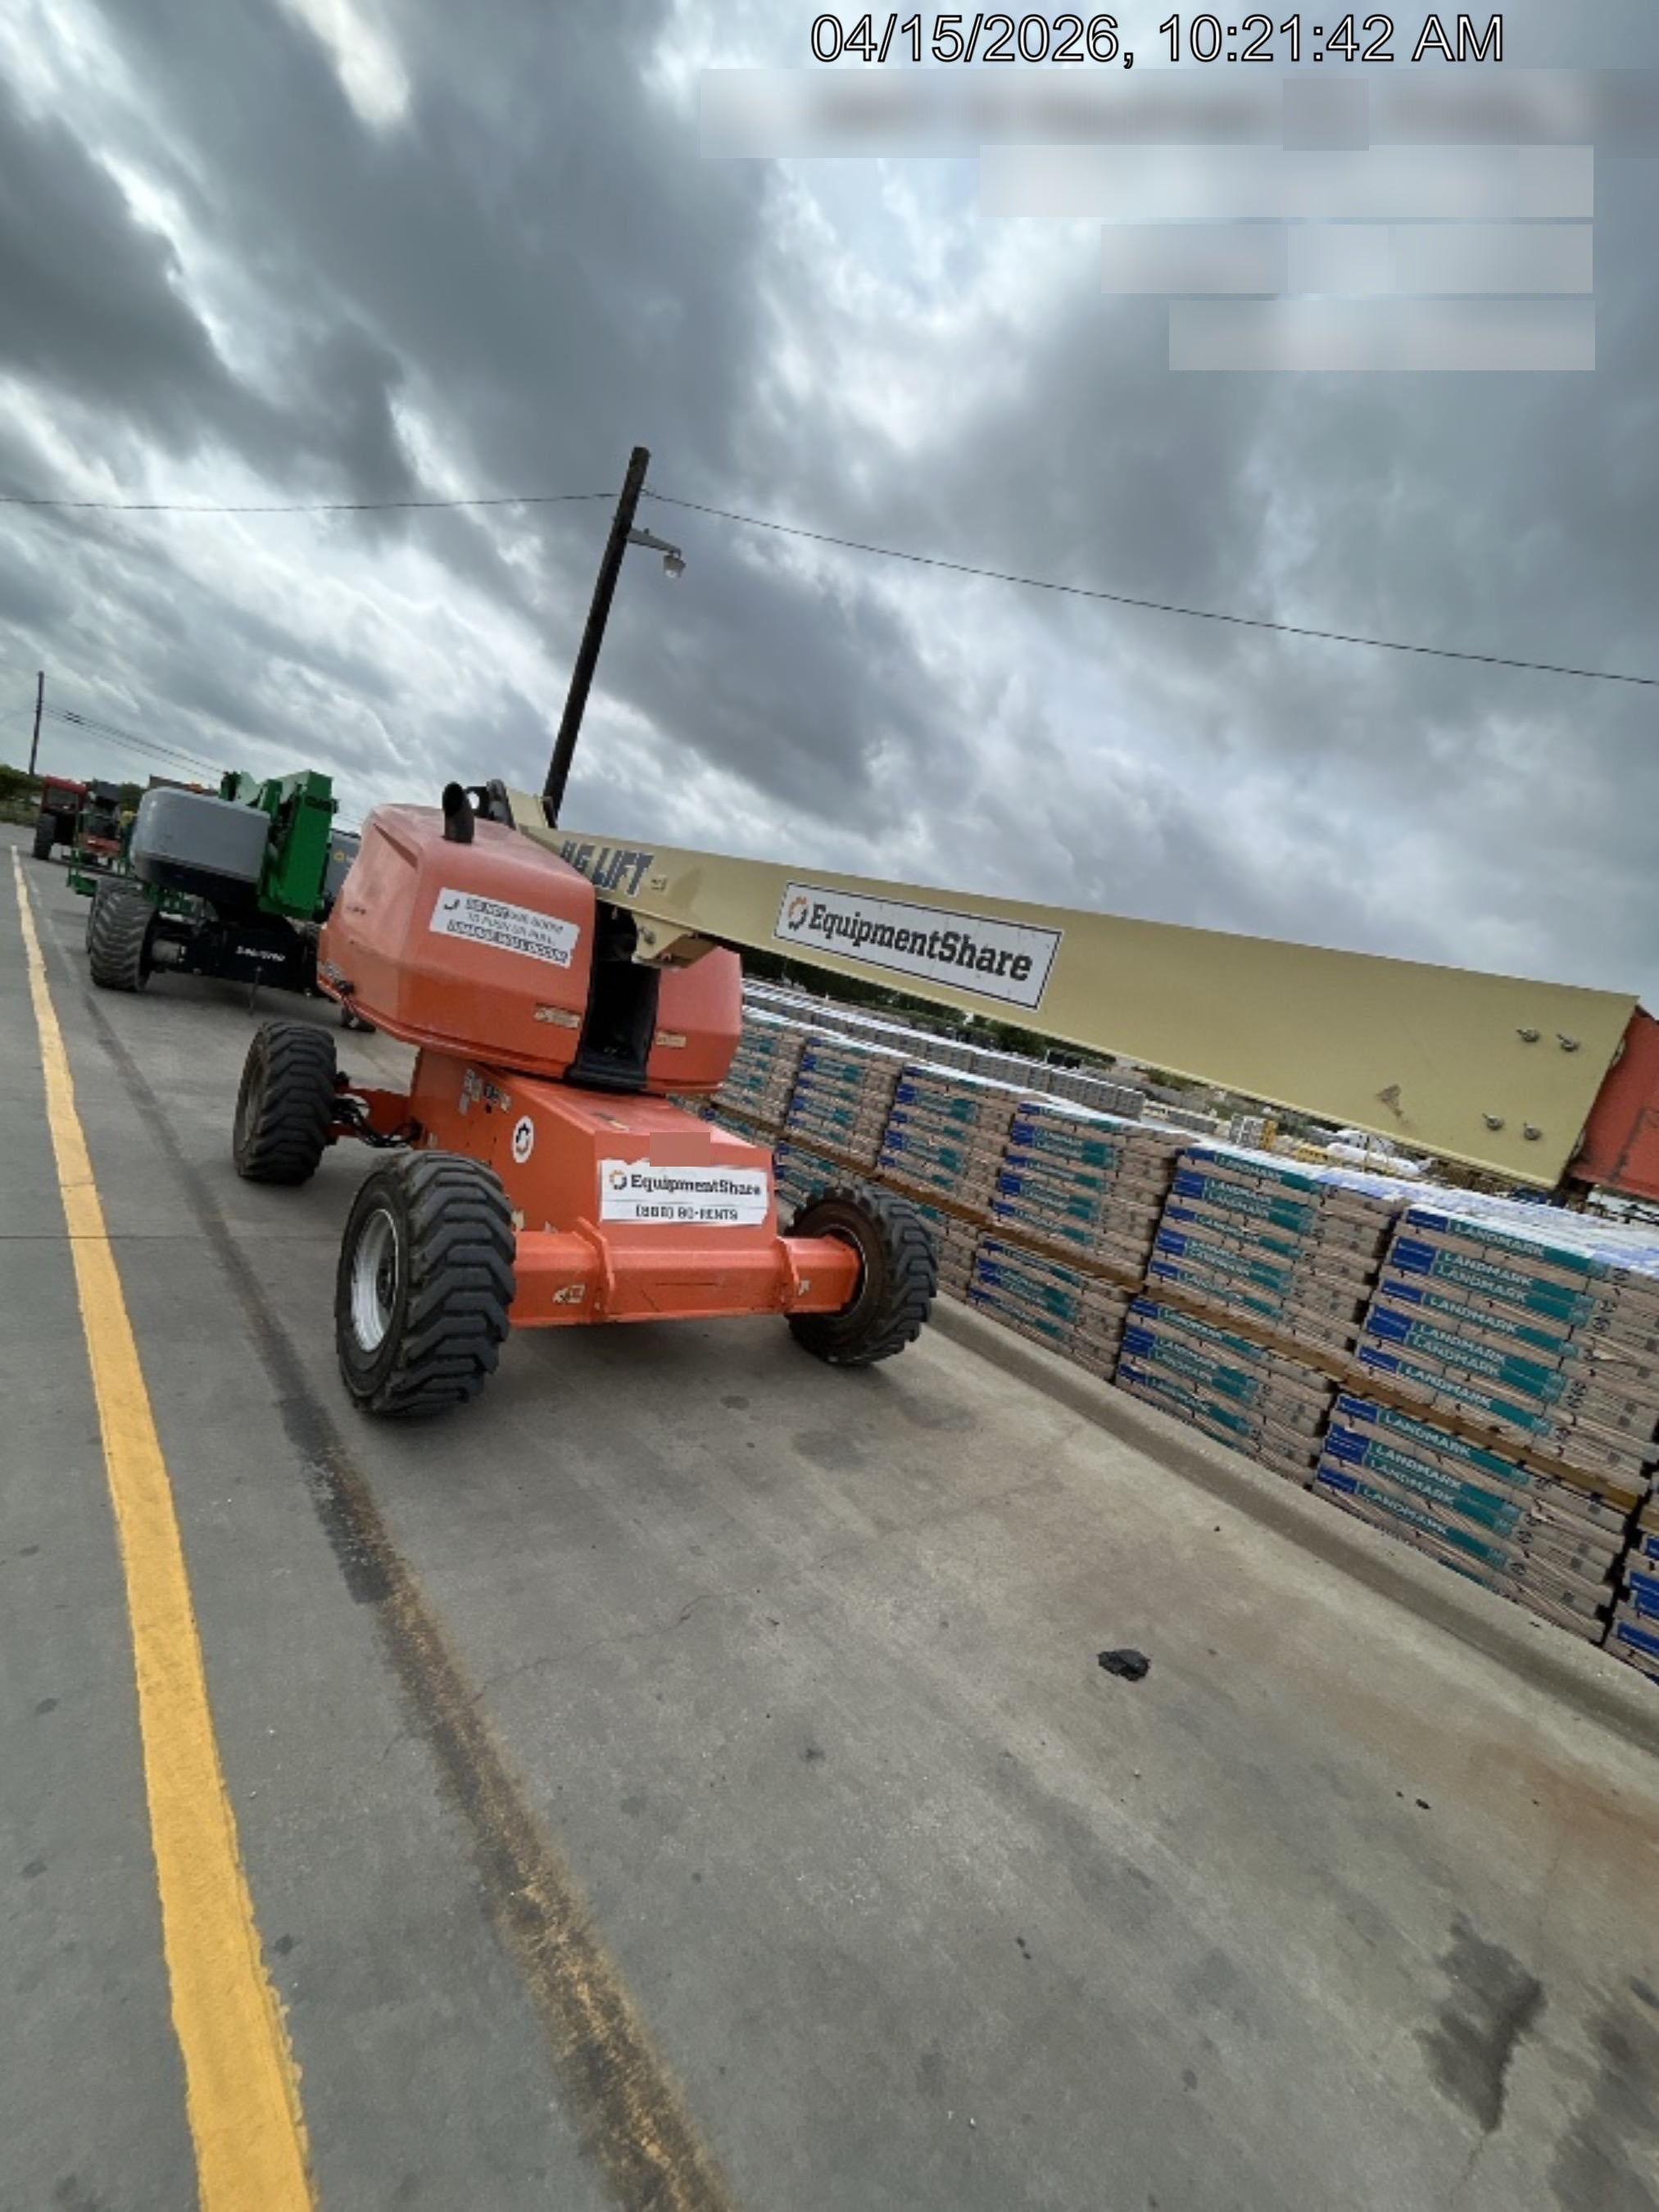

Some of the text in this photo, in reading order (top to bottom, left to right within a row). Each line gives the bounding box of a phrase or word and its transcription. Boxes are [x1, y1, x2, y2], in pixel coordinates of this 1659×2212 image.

[592, 846, 655, 896] LIFT
[809, 904, 1033, 981] EquipmentShare
[630, 1173, 761, 1195] EquipmentShare
[1444, 1253, 1533, 1289] LANDMARK
[1430, 1296, 1518, 1335] LANDMARK
[1385, 1414, 1472, 1458] LANDMARK
[1370, 1459, 1456, 1505] LANDMARK
[1376, 1444, 1462, 1491] LANDMARK
